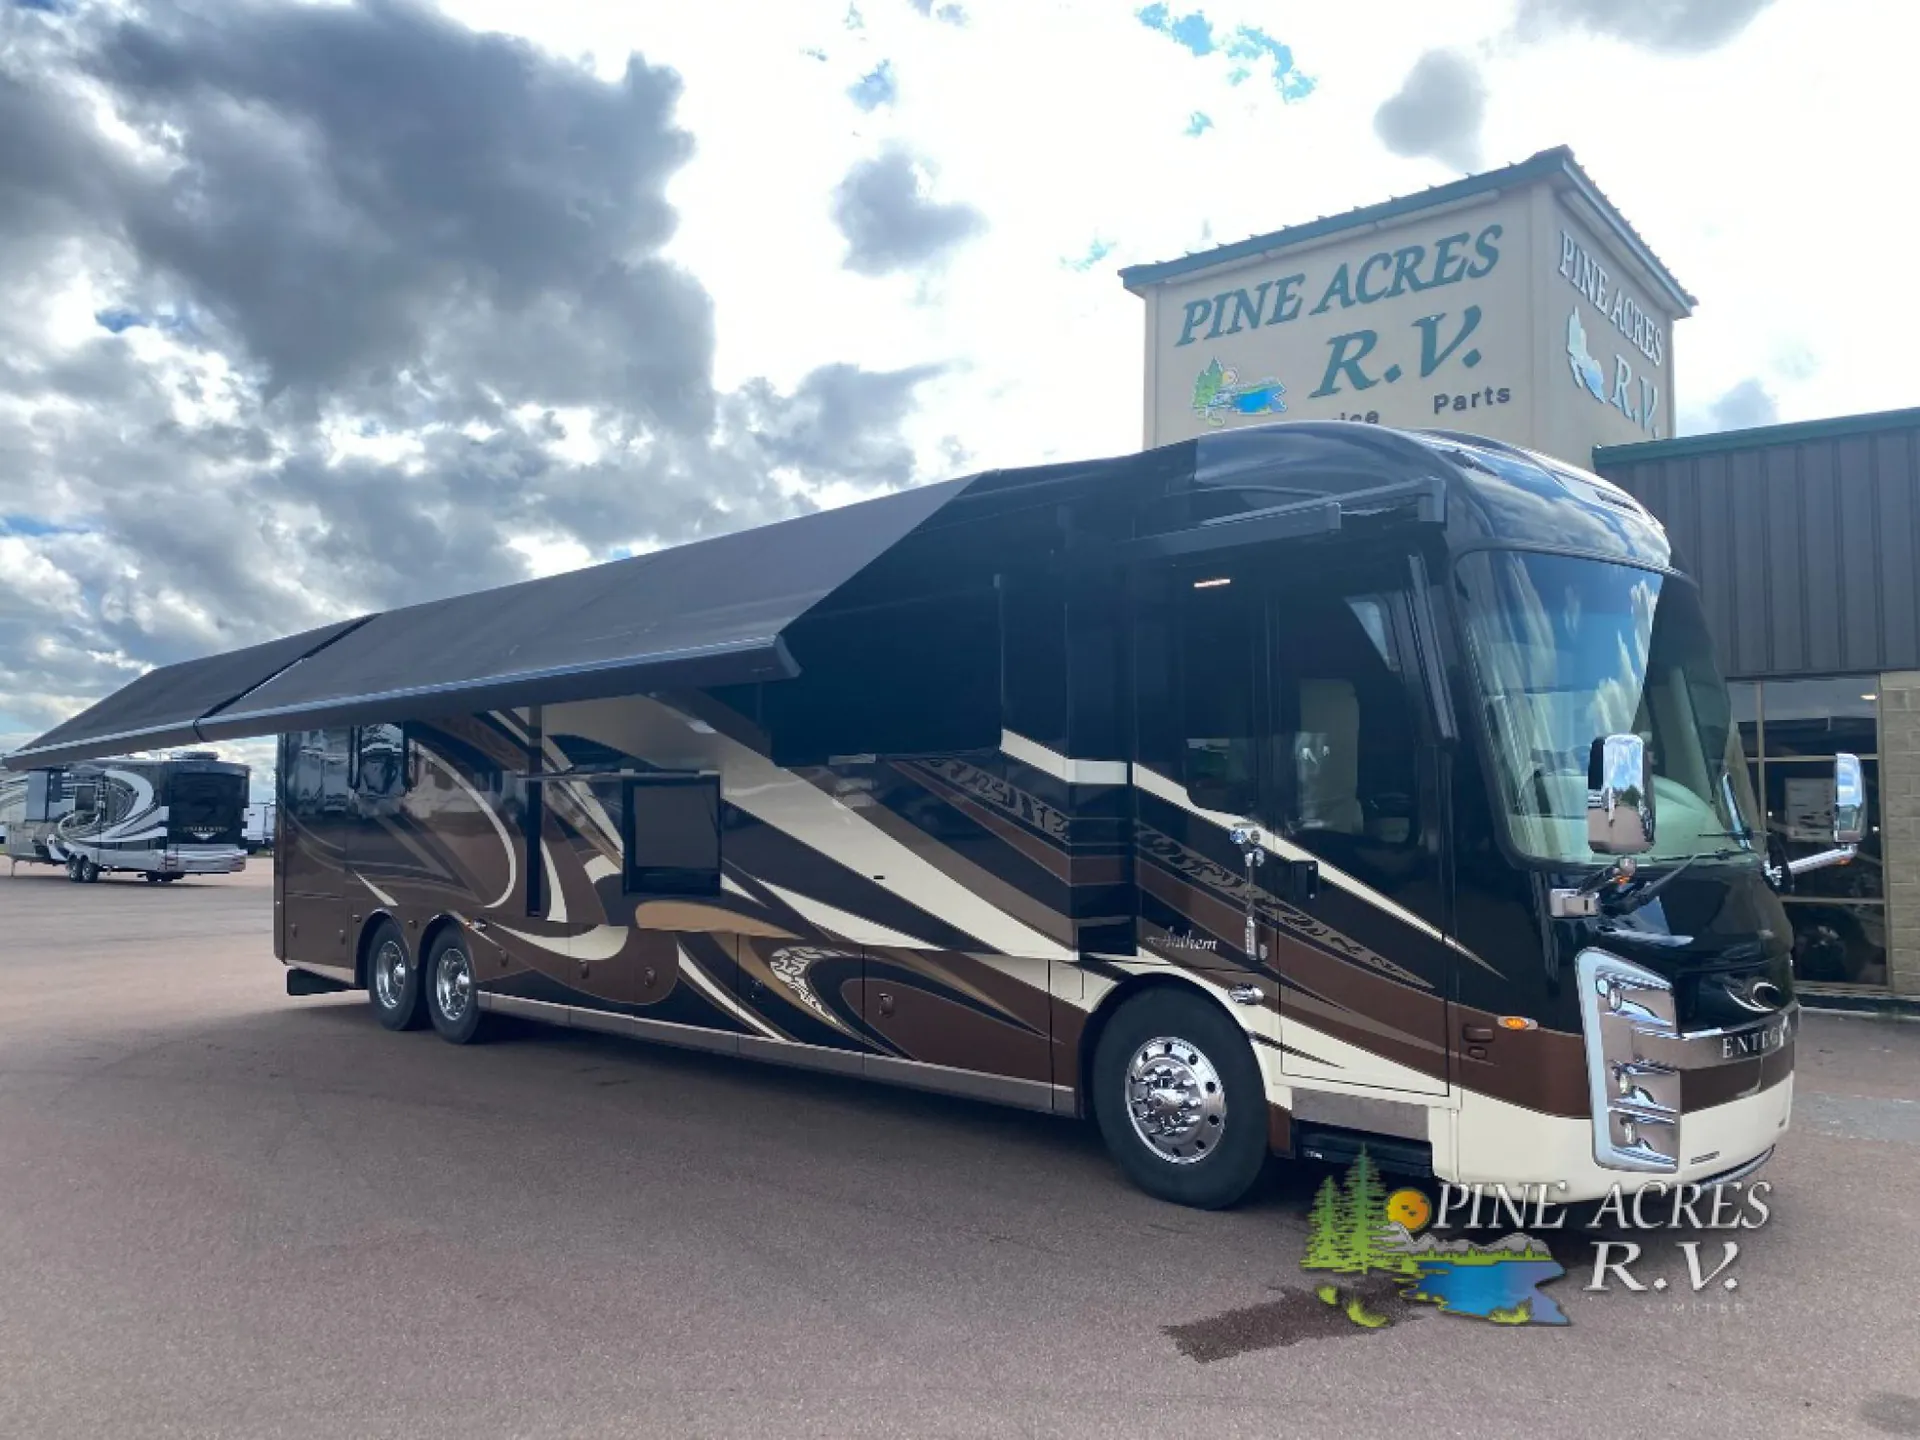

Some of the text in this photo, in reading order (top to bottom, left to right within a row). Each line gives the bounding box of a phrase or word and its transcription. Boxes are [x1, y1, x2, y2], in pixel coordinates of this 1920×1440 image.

[1174, 225, 1503, 347] PINE ACRES
[1559, 230, 1663, 367] PINE ACRES
[1308, 305, 1482, 399] R.V.
[1610, 353, 1660, 438] R.V.
[1433, 386, 1511, 414] Parts
[1146, 926, 1218, 950] Anthem
